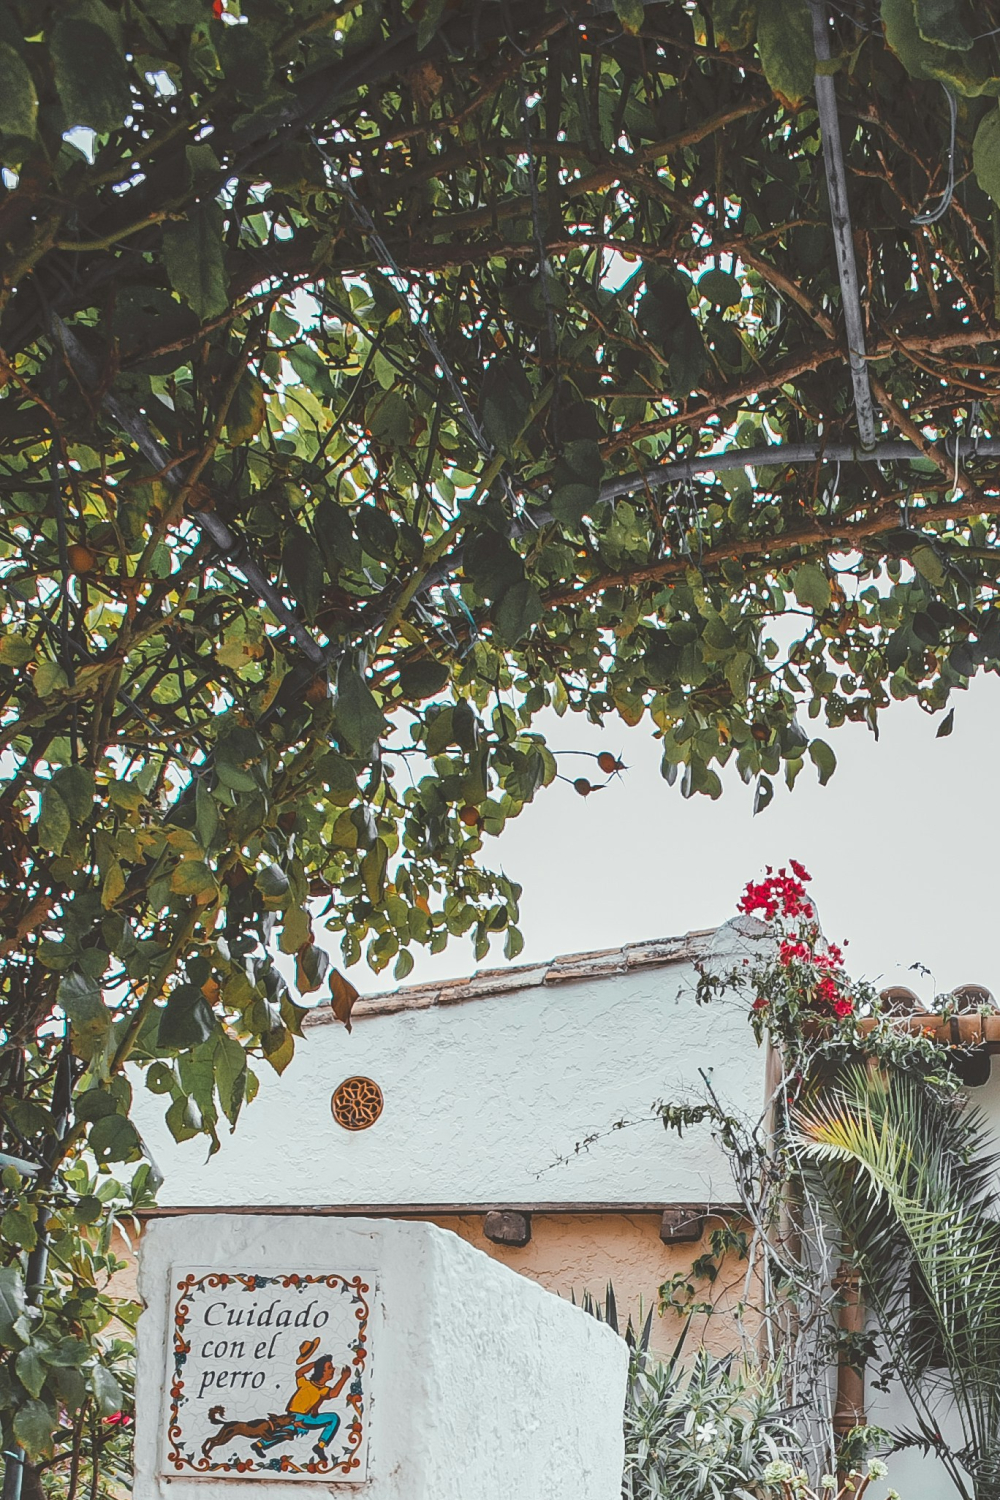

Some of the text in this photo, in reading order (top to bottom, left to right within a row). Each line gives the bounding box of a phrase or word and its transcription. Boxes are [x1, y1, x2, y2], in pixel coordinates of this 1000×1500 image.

[203, 1299, 330, 1328] Cuidado
[201, 1331, 283, 1360] con el
